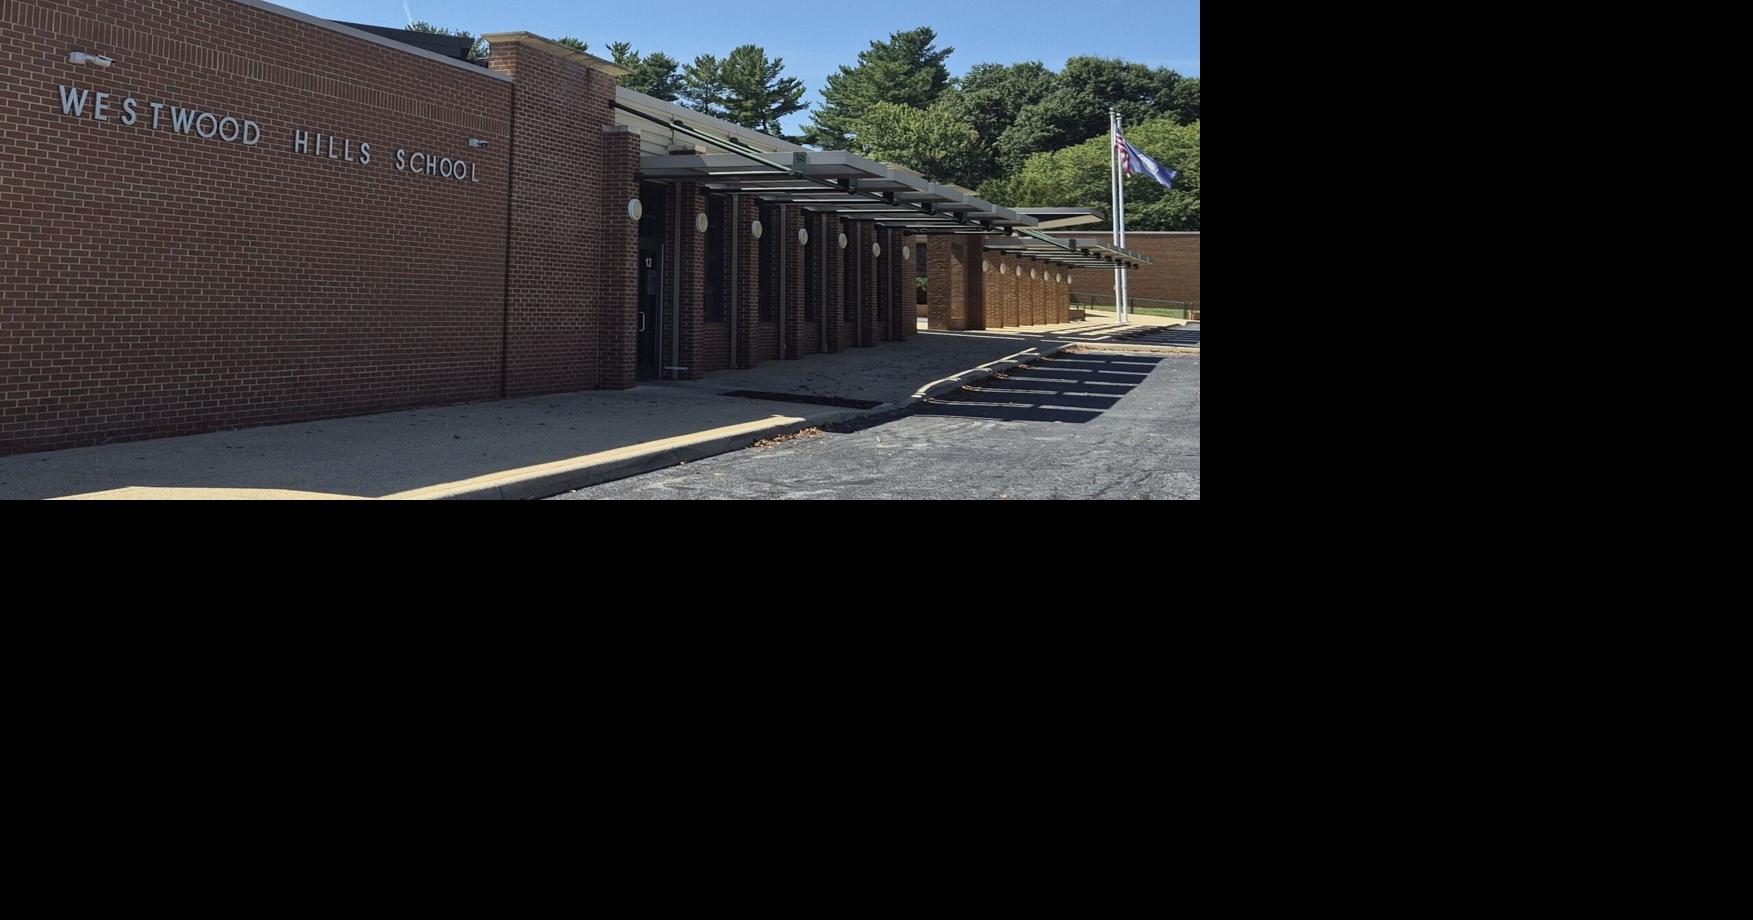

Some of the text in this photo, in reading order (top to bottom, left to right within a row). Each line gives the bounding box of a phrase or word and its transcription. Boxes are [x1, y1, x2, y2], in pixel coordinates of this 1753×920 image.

[58, 85, 480, 183] WESTWOOD HILLS SCHOOL
[645, 257, 652, 267] 12
